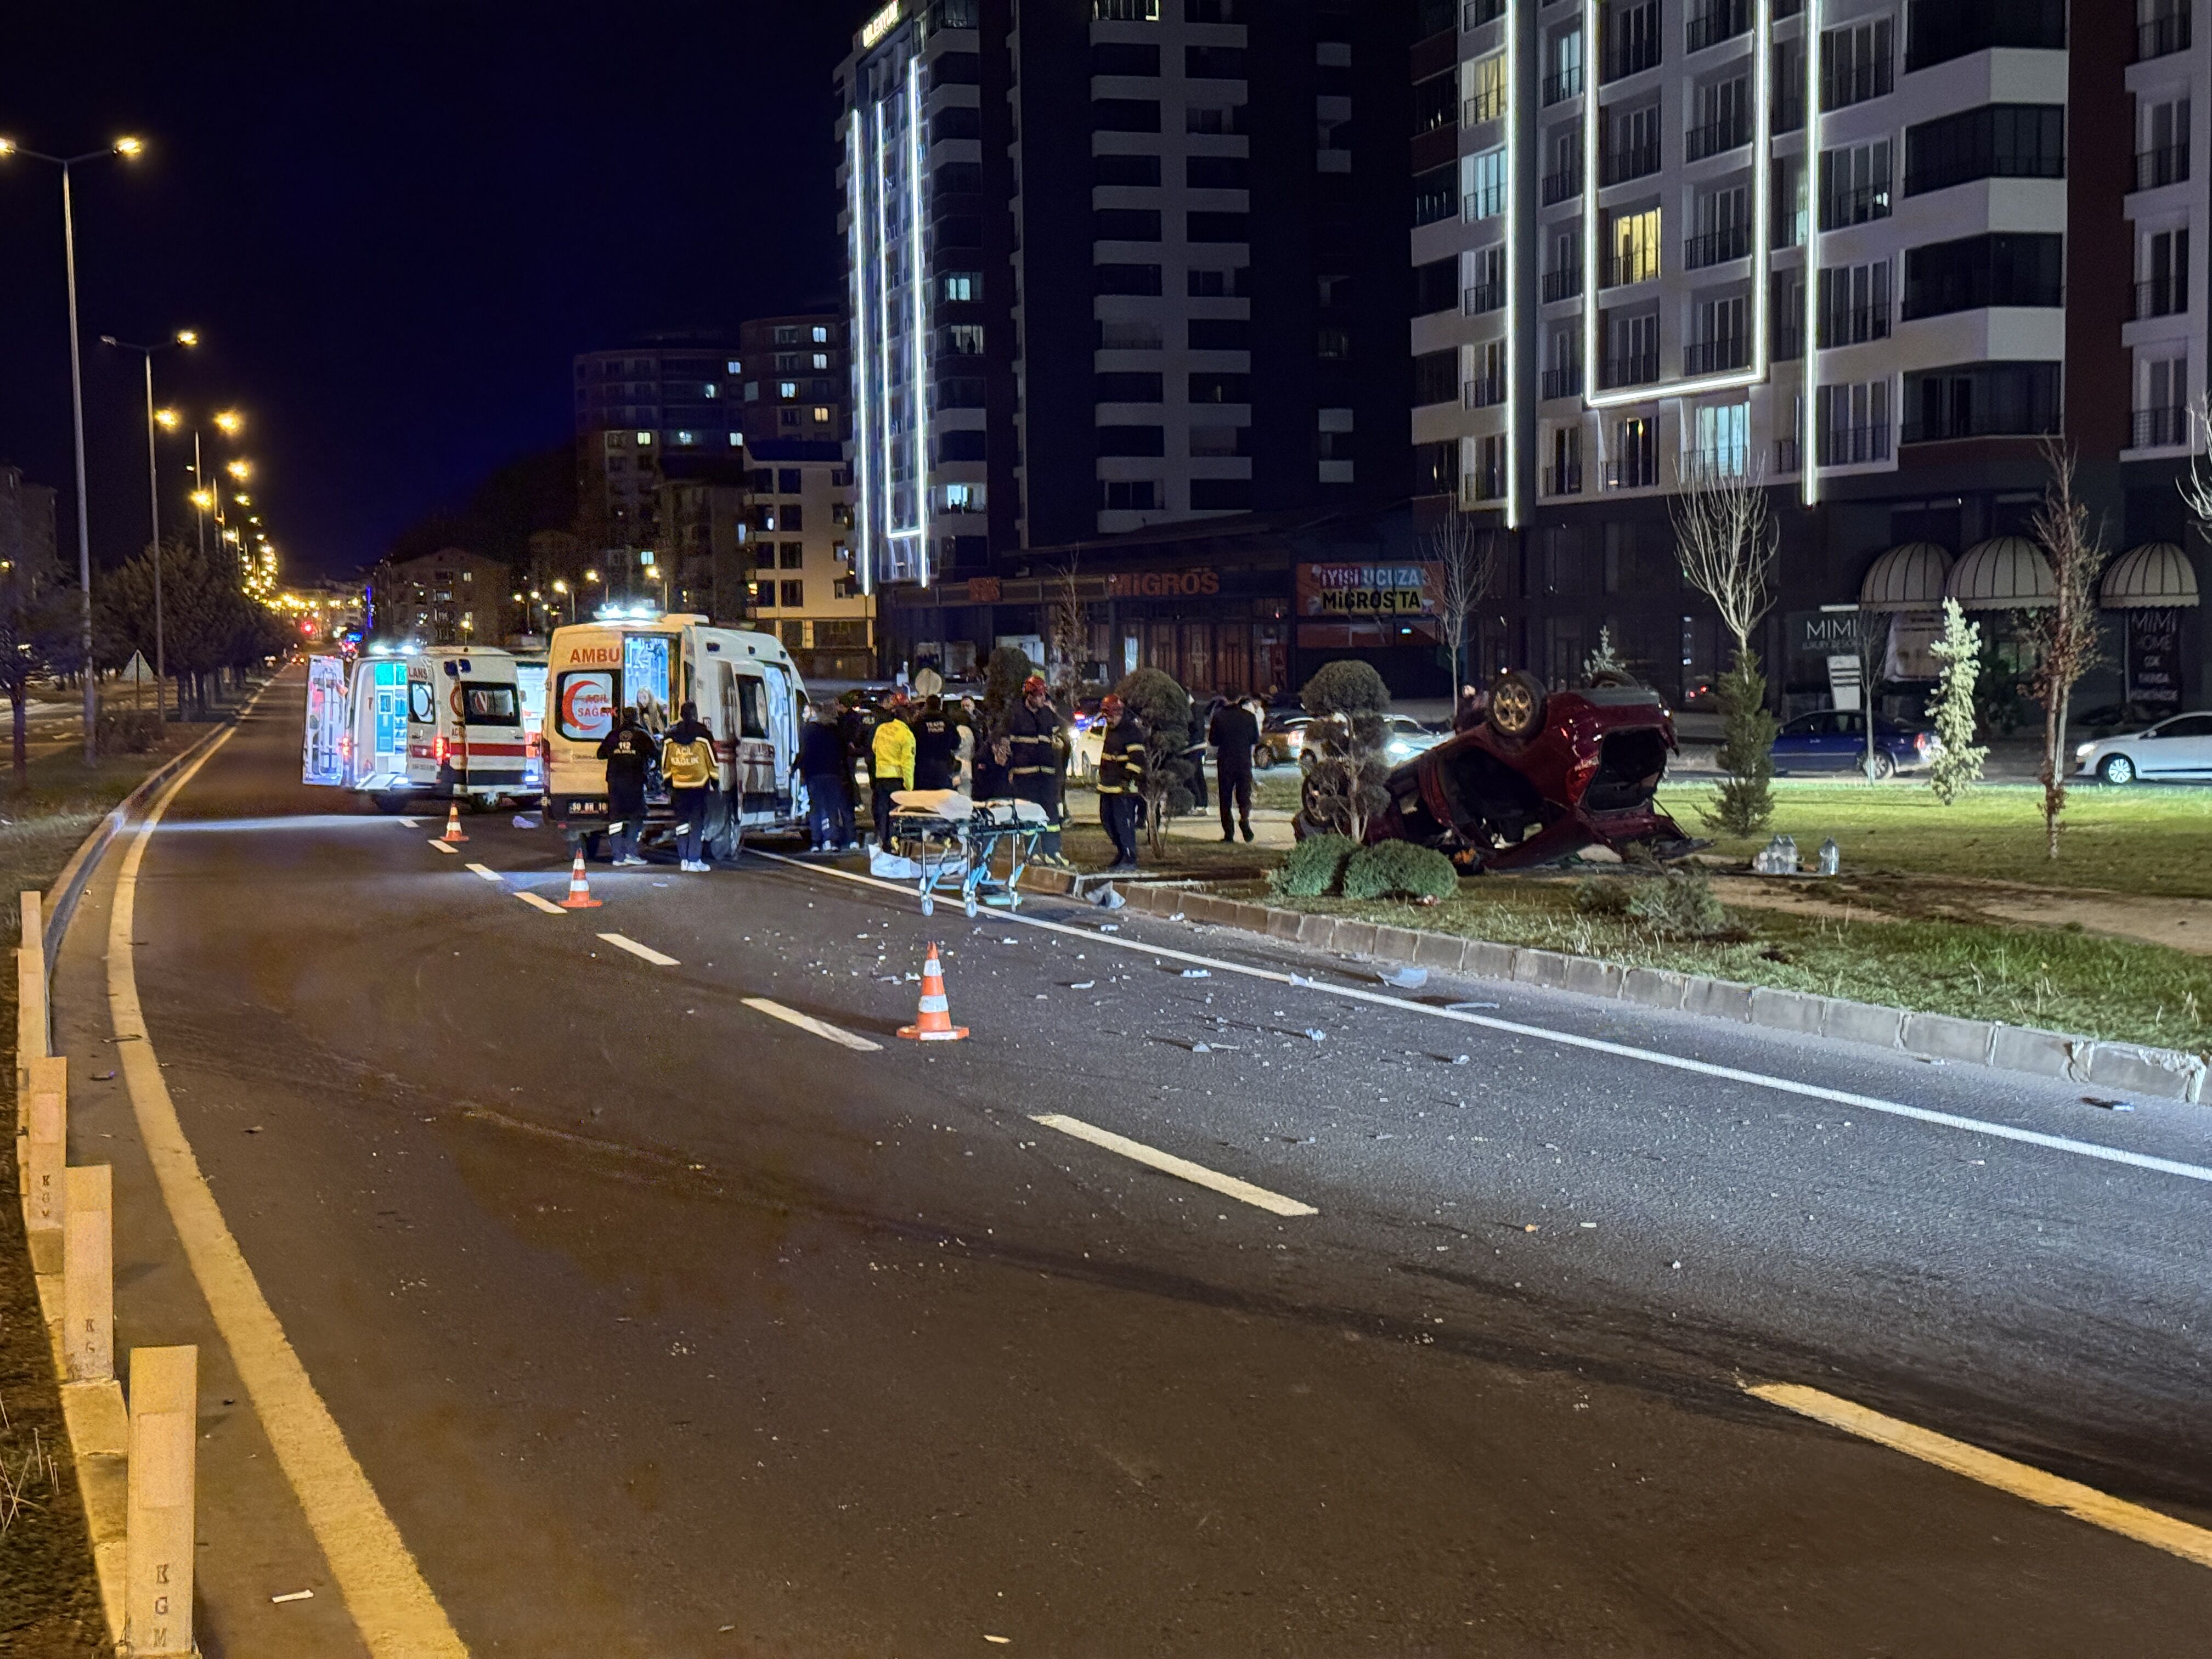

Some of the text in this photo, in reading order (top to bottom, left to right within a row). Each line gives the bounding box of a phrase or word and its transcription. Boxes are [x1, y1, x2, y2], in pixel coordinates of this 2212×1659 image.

[1363, 568, 1420, 586] UCUZA
[1807, 619, 1856, 639] MIMI
[569, 648, 620, 663] AMBU
[154, 1563, 170, 1647] KGM
